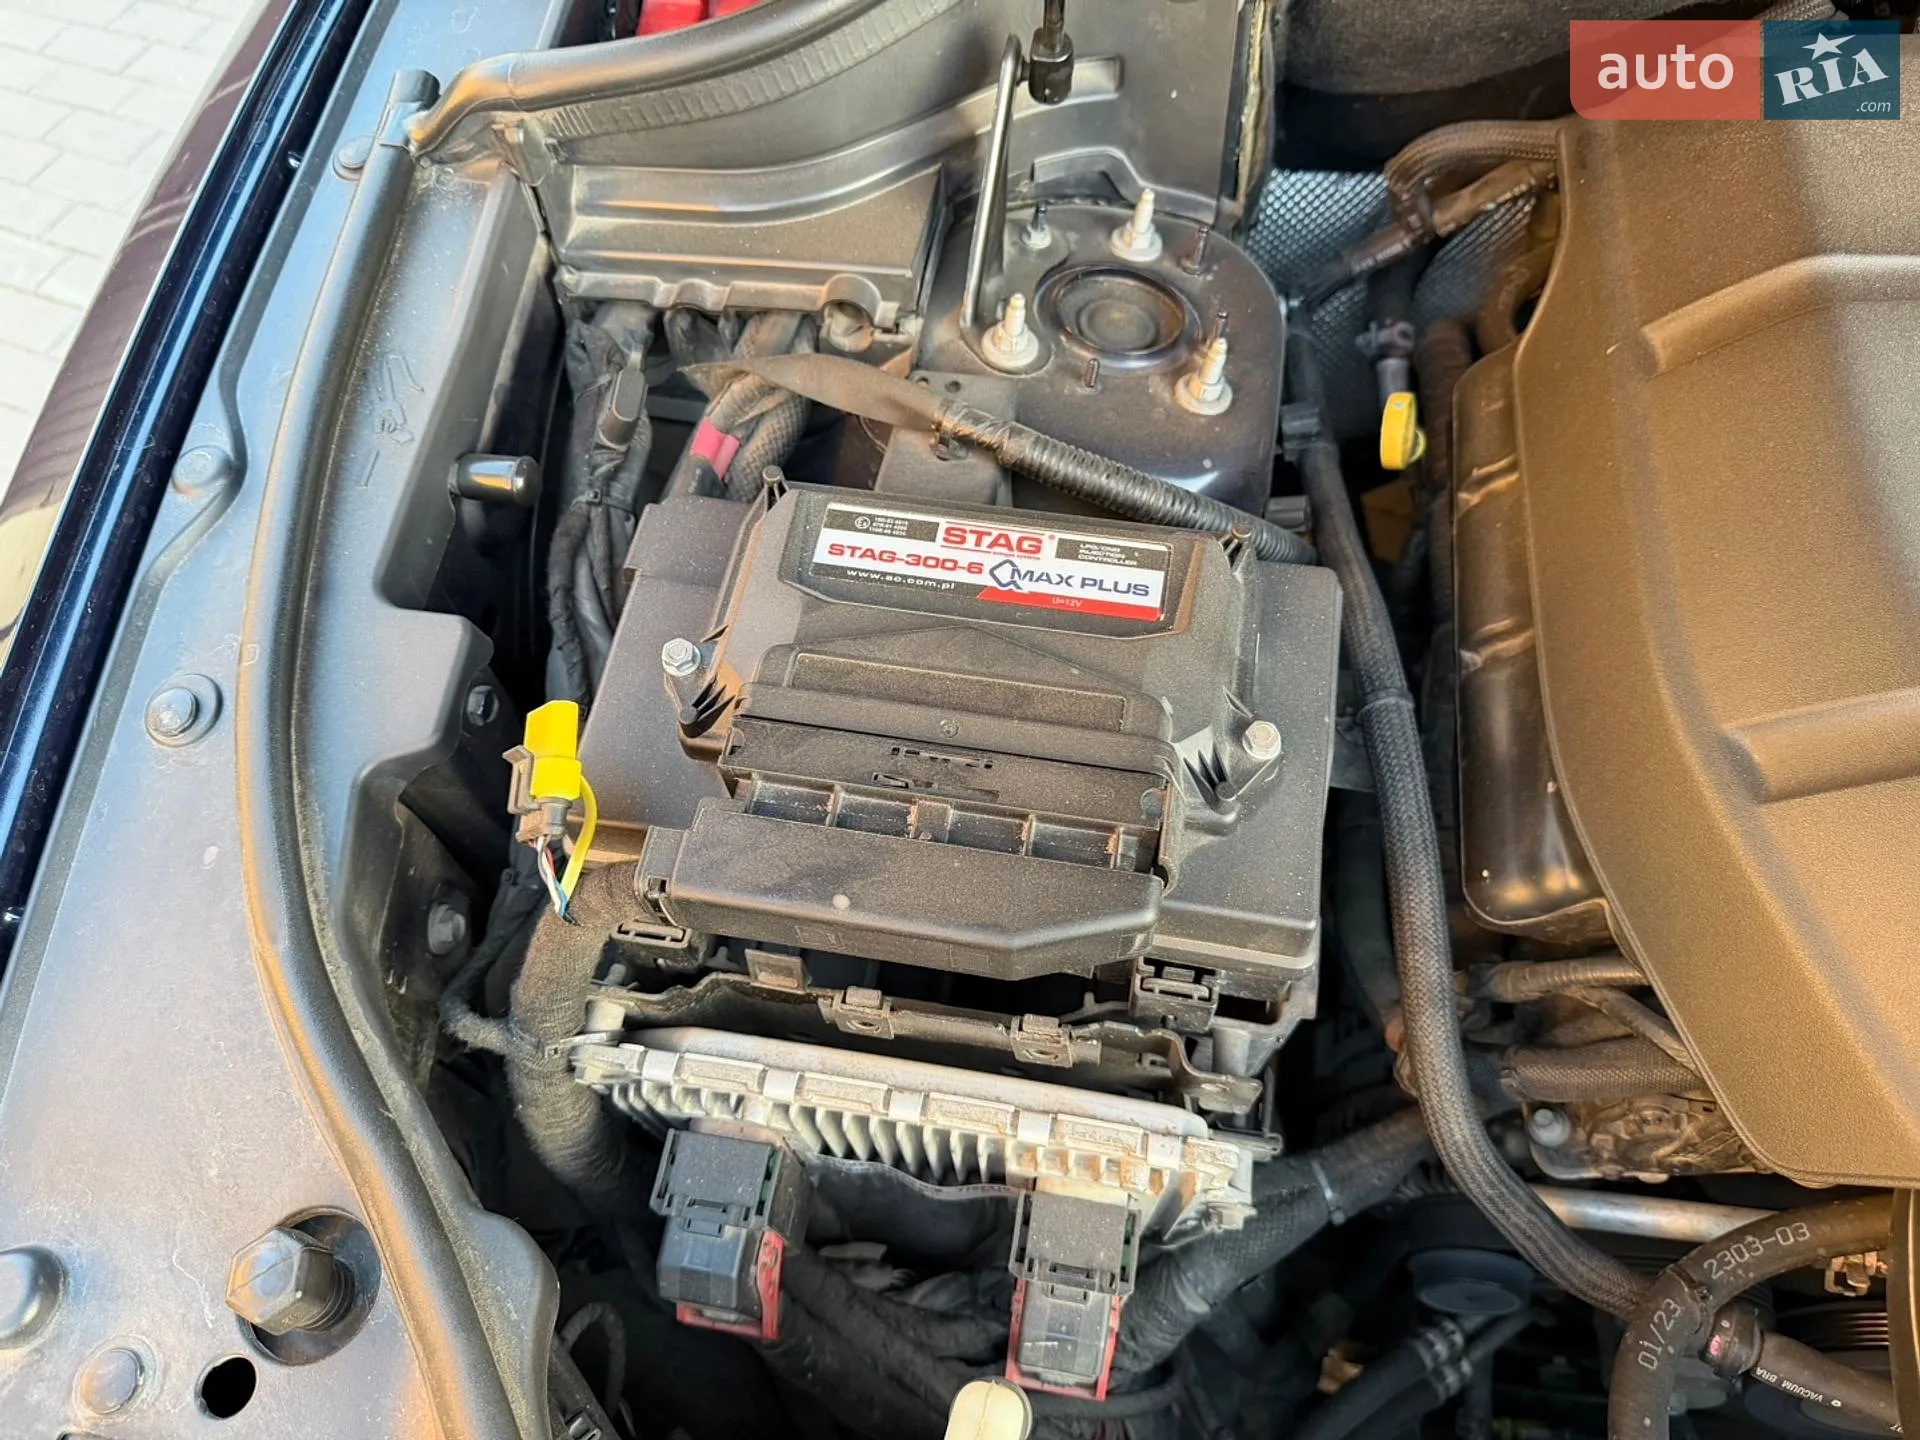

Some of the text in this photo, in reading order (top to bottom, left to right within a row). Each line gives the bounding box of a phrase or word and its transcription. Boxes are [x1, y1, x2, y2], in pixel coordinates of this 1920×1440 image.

[943, 527, 1043, 554] STAG
[828, 543, 985, 574] STAG-300-6
[846, 569, 956, 590] www.ac.com.pl
[1080, 577, 1150, 597] PLUS
[1703, 1222, 1811, 1280] 2303-03
[1637, 1298, 1681, 1370] 01/23
[1781, 1379, 1824, 1403] VACUUM
